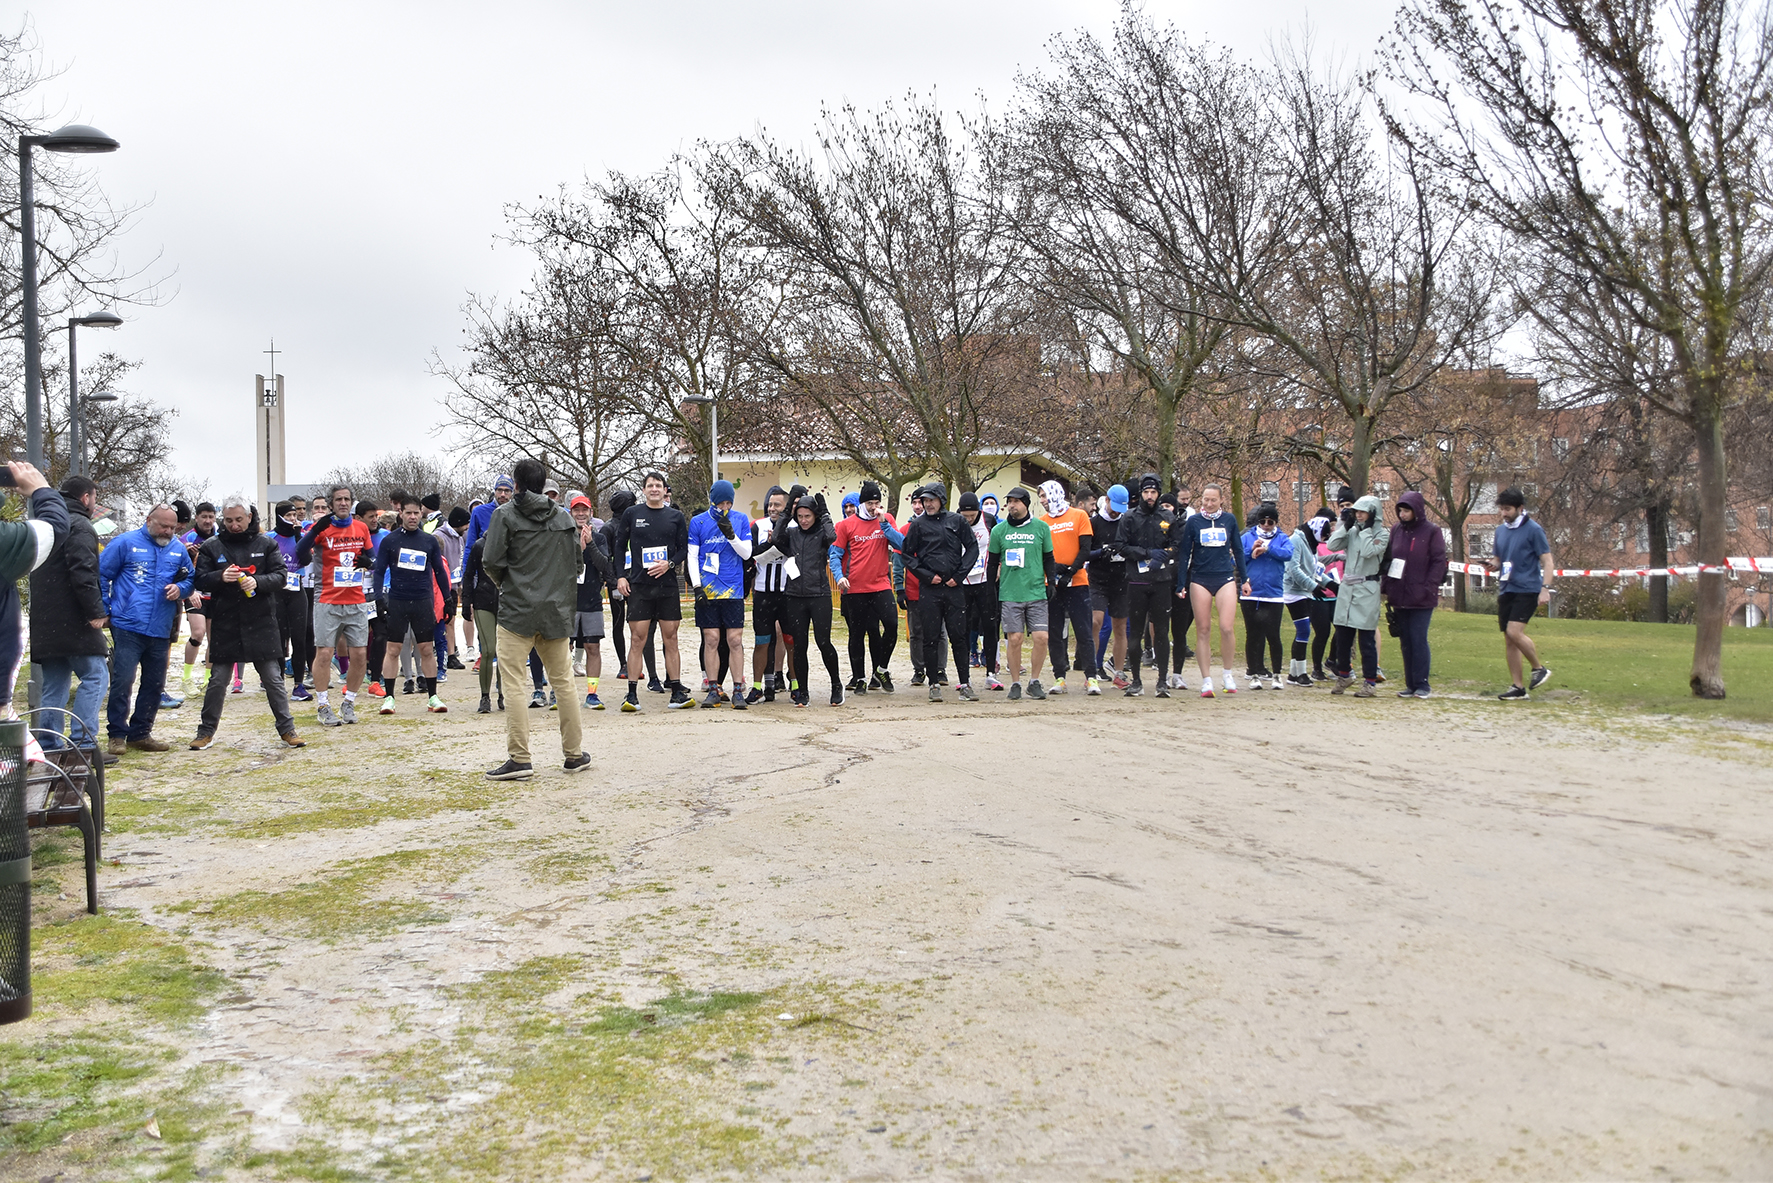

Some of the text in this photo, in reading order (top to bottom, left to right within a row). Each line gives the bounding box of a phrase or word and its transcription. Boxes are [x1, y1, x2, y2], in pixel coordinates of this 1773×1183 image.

[1005, 531, 1035, 540] adamo
[1207, 532, 1219, 540] 31
[409, 553, 417, 563] 6
[646, 551, 665, 561] 110
[341, 571, 356, 580] 87
